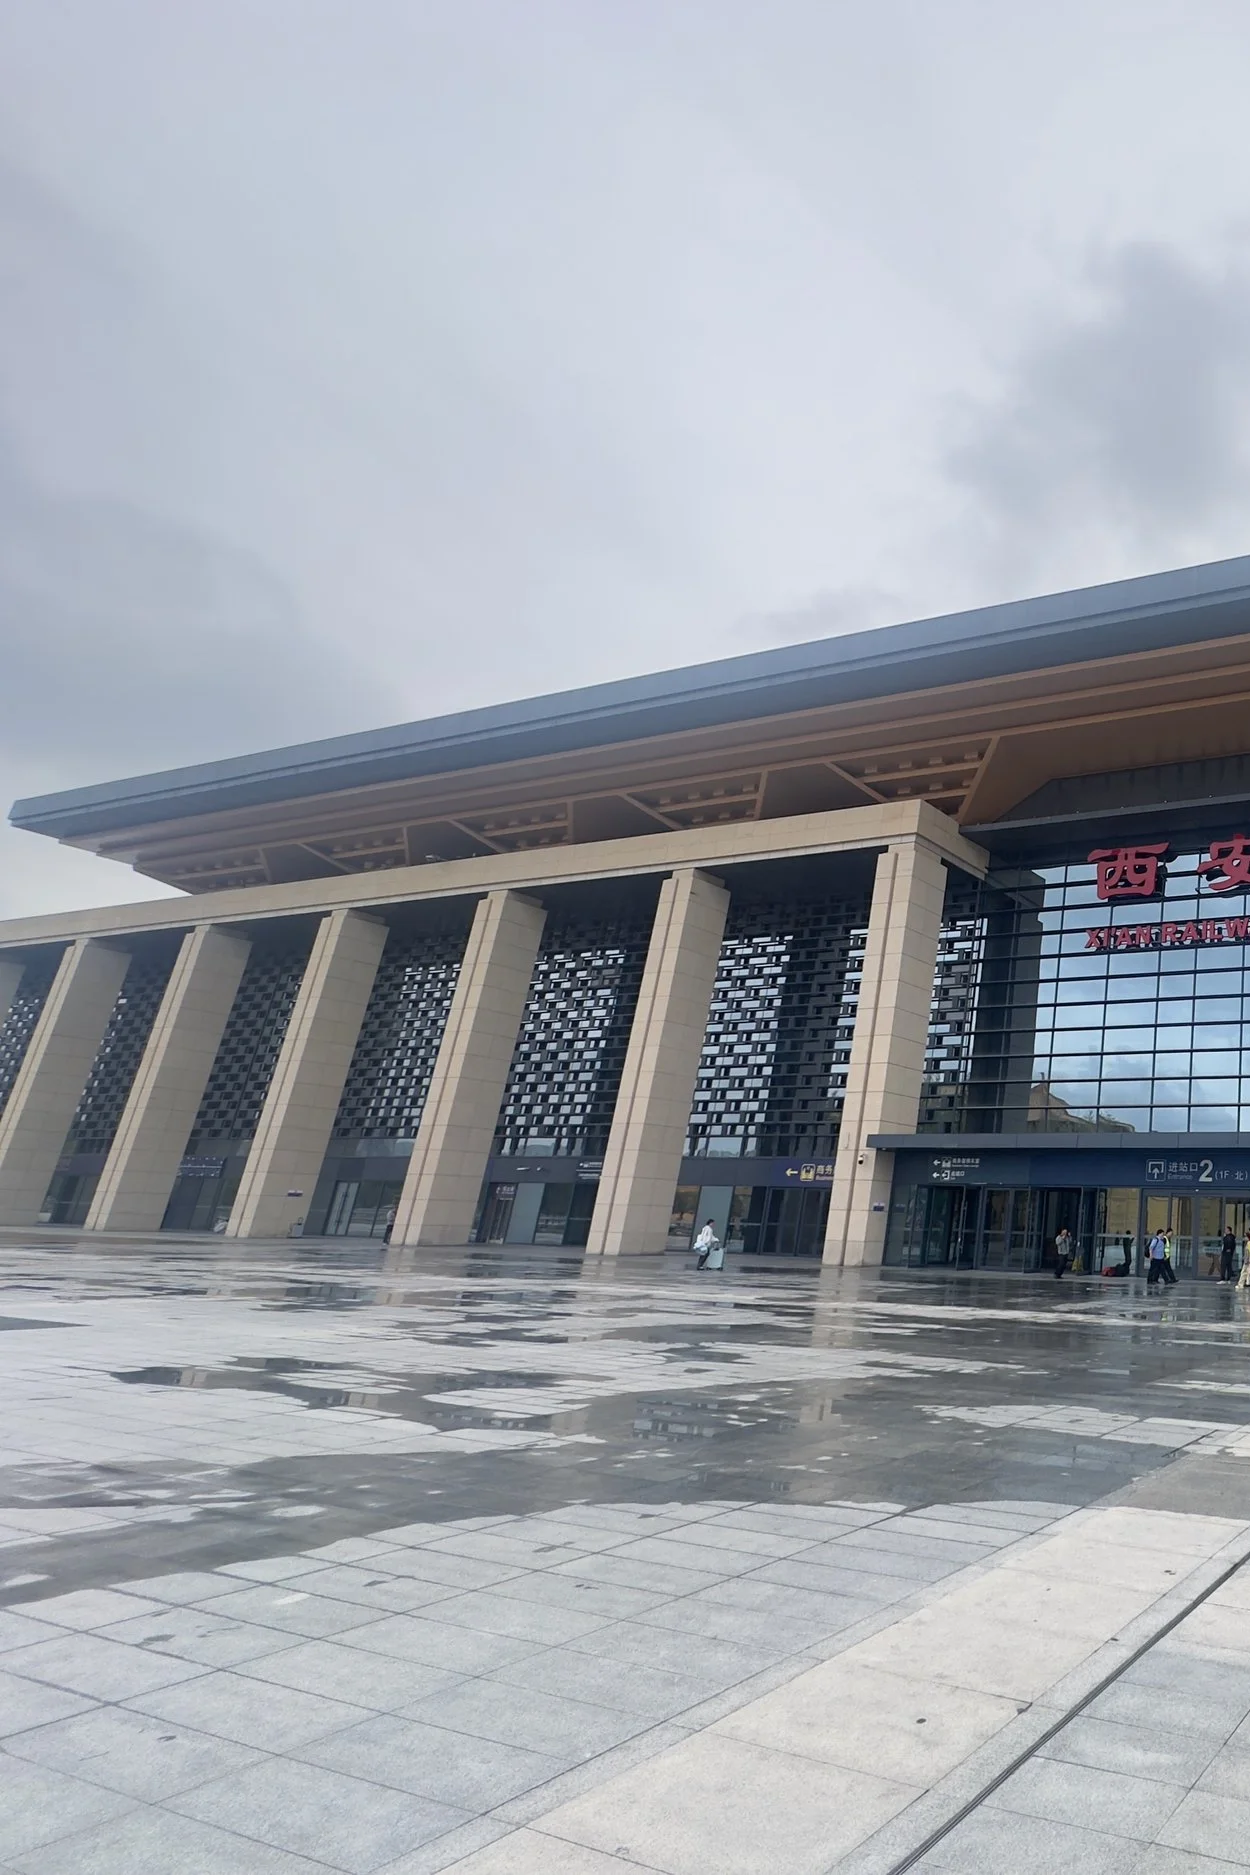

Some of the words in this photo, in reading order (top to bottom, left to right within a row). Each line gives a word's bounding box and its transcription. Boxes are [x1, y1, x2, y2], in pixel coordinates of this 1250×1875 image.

[1084, 925, 1152, 949] XI'AN
[1168, 1162, 1198, 1172] 进站口
[1198, 1159, 1213, 1182] 2
